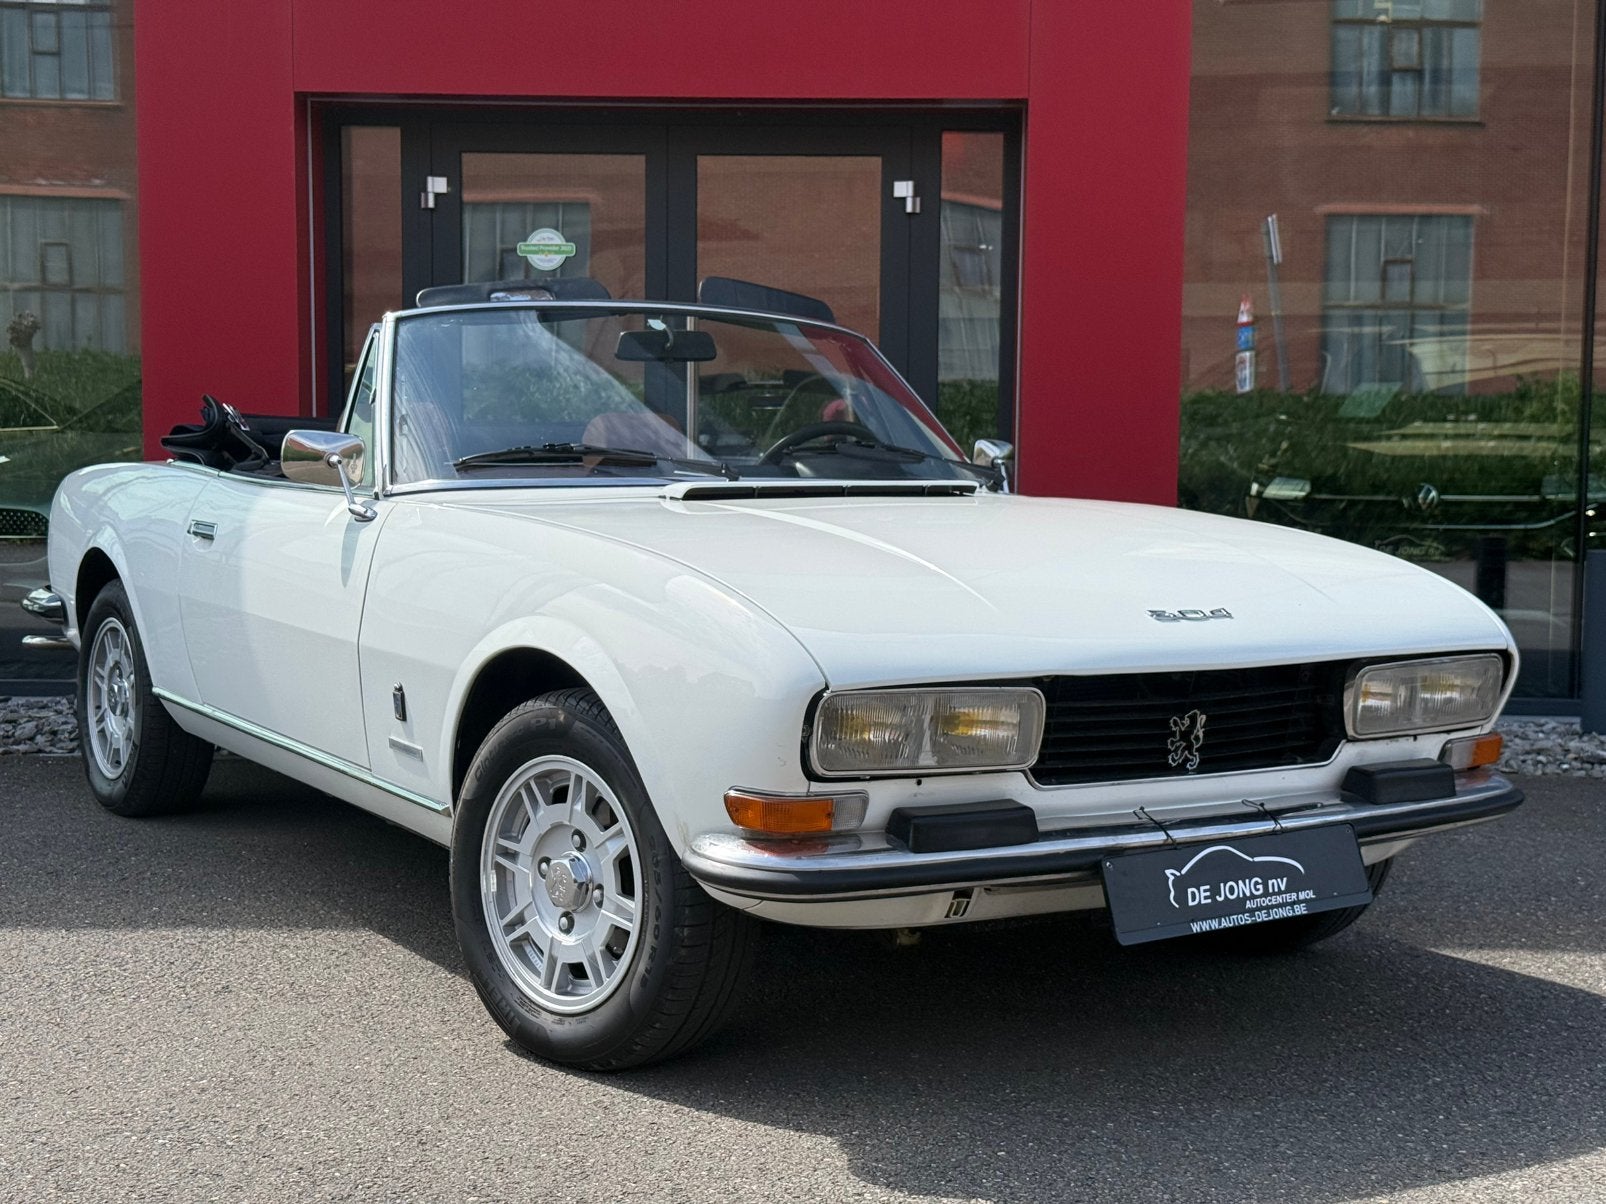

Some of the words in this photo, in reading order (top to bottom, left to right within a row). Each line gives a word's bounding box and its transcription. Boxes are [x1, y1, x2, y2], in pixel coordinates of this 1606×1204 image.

[1146, 607, 1234, 622] 504
[1187, 885, 1212, 906] DE
[1216, 877, 1264, 902] JONG
[1268, 877, 1287, 893] nv
[1245, 892, 1297, 909] AUTOCENTER
[1298, 889, 1316, 901] MOL
[1190, 903, 1308, 934] WWW.AUTOS-DEJONG.BE
